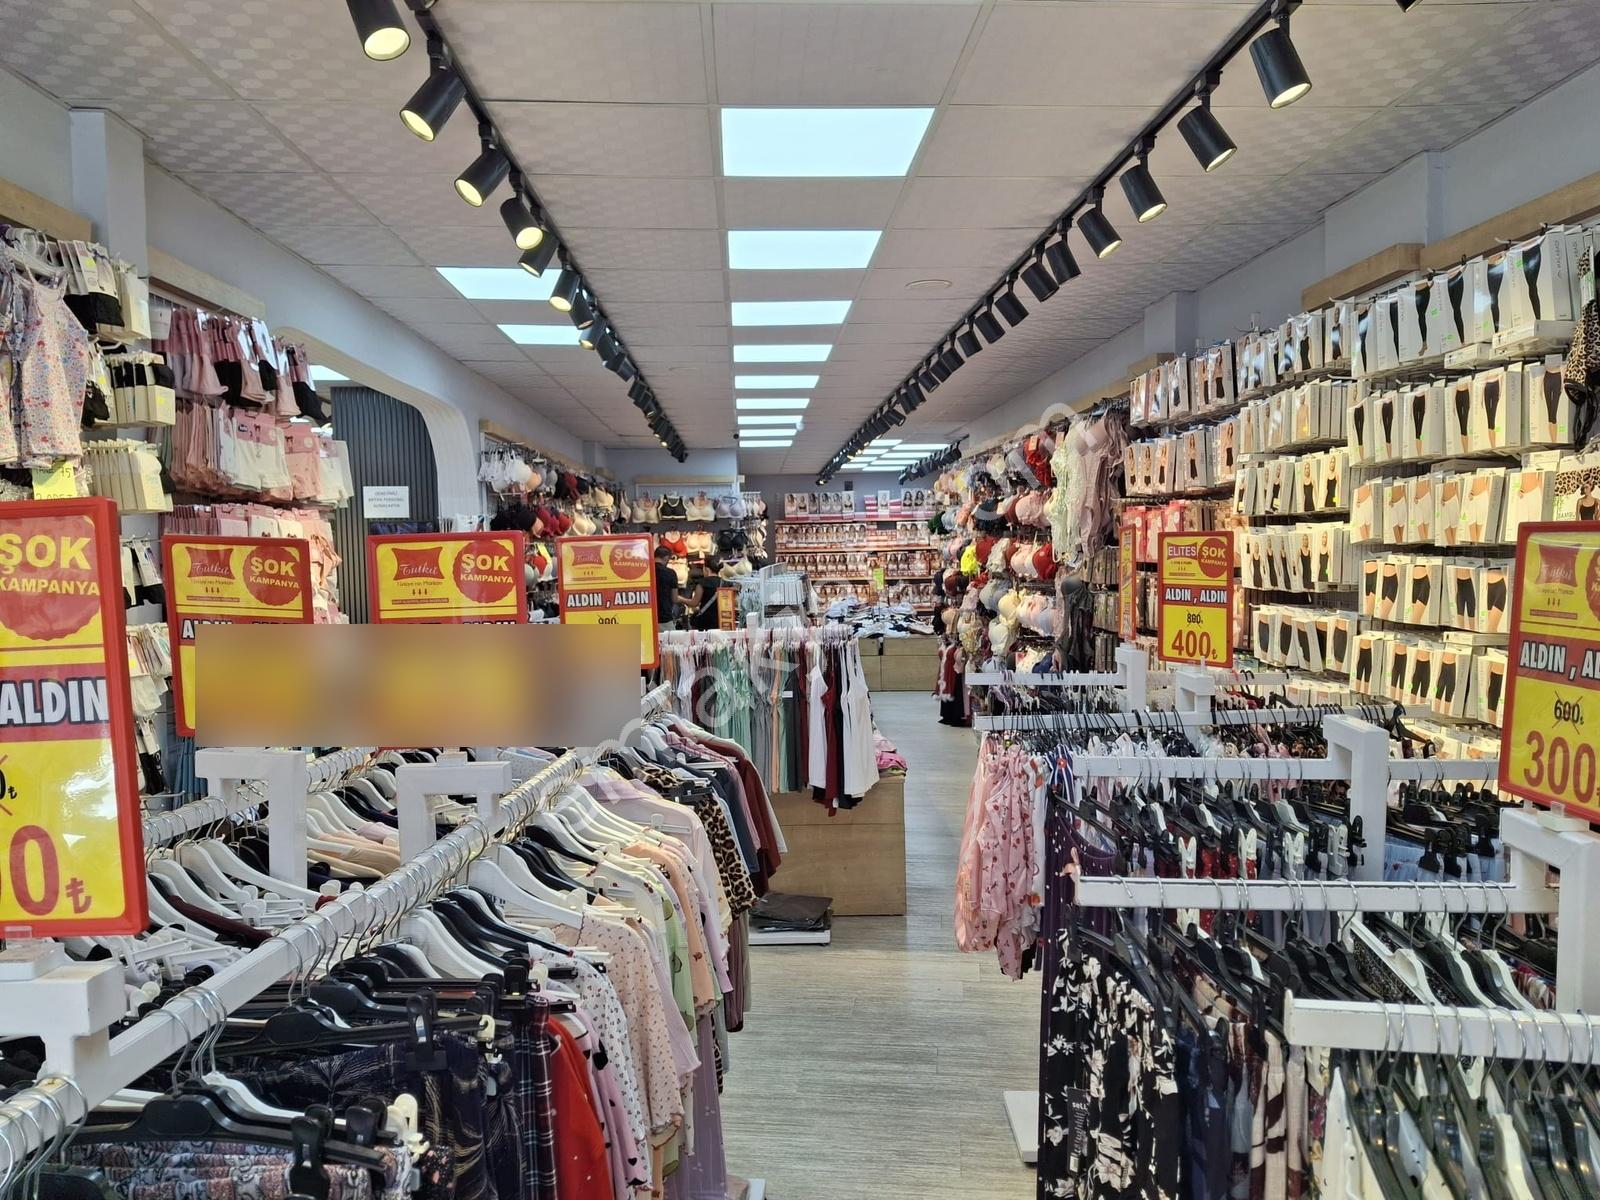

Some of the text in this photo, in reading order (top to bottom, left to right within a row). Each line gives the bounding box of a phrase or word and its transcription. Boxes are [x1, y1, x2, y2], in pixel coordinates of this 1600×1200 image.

[0, 533, 92, 574] ŞOK
[614, 548, 643, 560] ŞO
[1202, 547, 1226, 558] ŞOK
[250, 557, 296, 576] ŞOK
[461, 554, 510, 573] ŞOK
[614, 561, 648, 569] KAMPANYA
[249, 576, 299, 588] KAMPANYA
[460, 573, 514, 584] KAMPANYA
[567, 593, 602, 607] ALDIN
[614, 591, 649, 605] ALDIN
[1165, 588, 1191, 601] ALDIN
[1200, 590, 1227, 603] ALDIN
[1520, 641, 1566, 673] ALDIN
[0, 679, 109, 725] ALDIN
